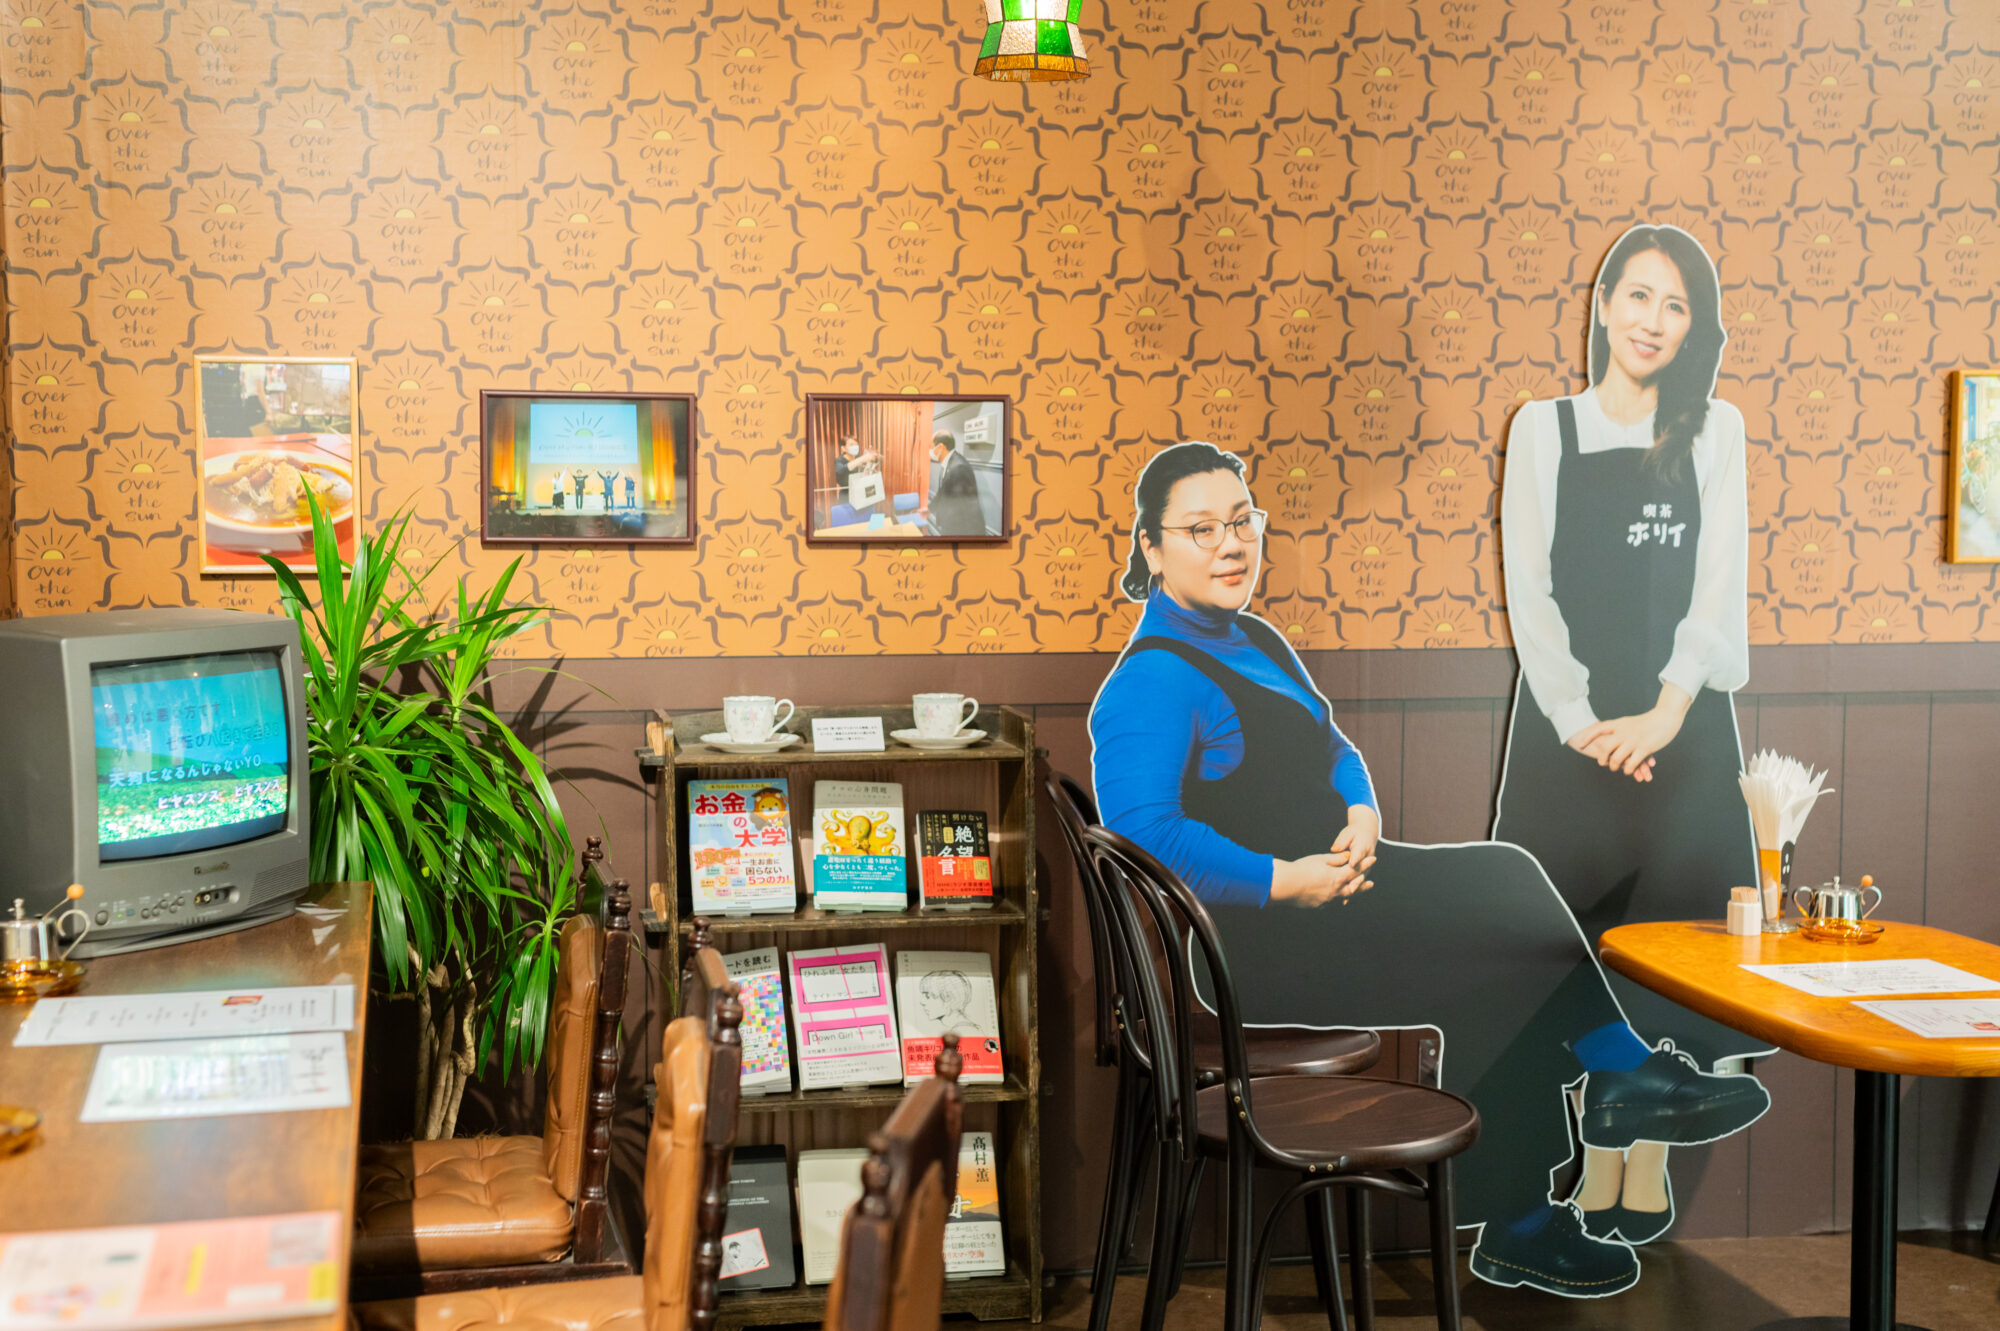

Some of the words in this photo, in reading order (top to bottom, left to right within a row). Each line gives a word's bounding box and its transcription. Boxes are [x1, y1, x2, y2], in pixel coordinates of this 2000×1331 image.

[1593, 18, 1624, 33] the
[726, 76, 762, 91] the
[1207, 78, 1246, 92] Over
[1210, 91, 1243, 106] the
[110, 141, 150, 158] the
[643, 159, 680, 174] the
[968, 155, 1009, 169] Over
[1127, 158, 1169, 172] Over
[1283, 161, 1321, 175] Over
[972, 168, 1006, 183] the
[1130, 171, 1165, 186] the
[1286, 174, 1318, 189] the
[15, 213, 64, 228] Over
[20, 227, 61, 244] the
[206, 233, 246, 248] the
[727, 245, 763, 260] the
[1047, 239, 1086, 253] Over
[1204, 241, 1243, 255] Over
[1050, 252, 1084, 267] the
[1208, 254, 1240, 269] the
[1804, 260, 1834, 275] the
[112, 303, 159, 318] Over
[117, 317, 157, 334] the
[299, 322, 337, 337] the
[967, 319, 1007, 333] Over
[1125, 321, 1164, 335] Over
[1279, 322, 1318, 336] Over
[645, 328, 681, 343] the
[971, 332, 1004, 347] the
[1128, 334, 1162, 349] the
[1283, 335, 1315, 350] the
[21, 391, 70, 406] Over
[26, 405, 67, 420] the
[390, 408, 427, 423] the
[1046, 402, 1085, 415] Over
[1201, 403, 1240, 416] Over
[728, 412, 764, 427] the
[1049, 414, 1083, 429] the
[1205, 415, 1236, 430] the
[1357, 415, 1388, 430] the
[1798, 415, 1828, 430] the
[117, 478, 163, 493] Over
[1276, 482, 1314, 495] Over
[123, 492, 161, 507] the
[1280, 494, 1312, 509] the
[1866, 492, 1896, 505] the
[1643, 503, 1672, 518] 喫茶
[1627, 521, 1687, 547] ホリイ
[27, 565, 74, 580] Over
[560, 563, 601, 577] Over
[726, 562, 766, 576] Over
[887, 561, 927, 575] Over
[1045, 561, 1083, 574] Over
[1350, 560, 1389, 573] Over
[729, 575, 764, 590] the
[891, 574, 924, 589] the
[1048, 573, 1081, 588] the
[1353, 572, 1386, 587] the
[1793, 568, 1823, 583] the
[32, 579, 72, 594] the
[564, 576, 600, 591] the
[695, 792, 747, 815] お金
[733, 816, 747, 828] の
[734, 828, 786, 847] 大学
[746, 867, 782, 875] 困らない
[811, 1033, 836, 1042] Down
[838, 1032, 853, 1040] Girl
